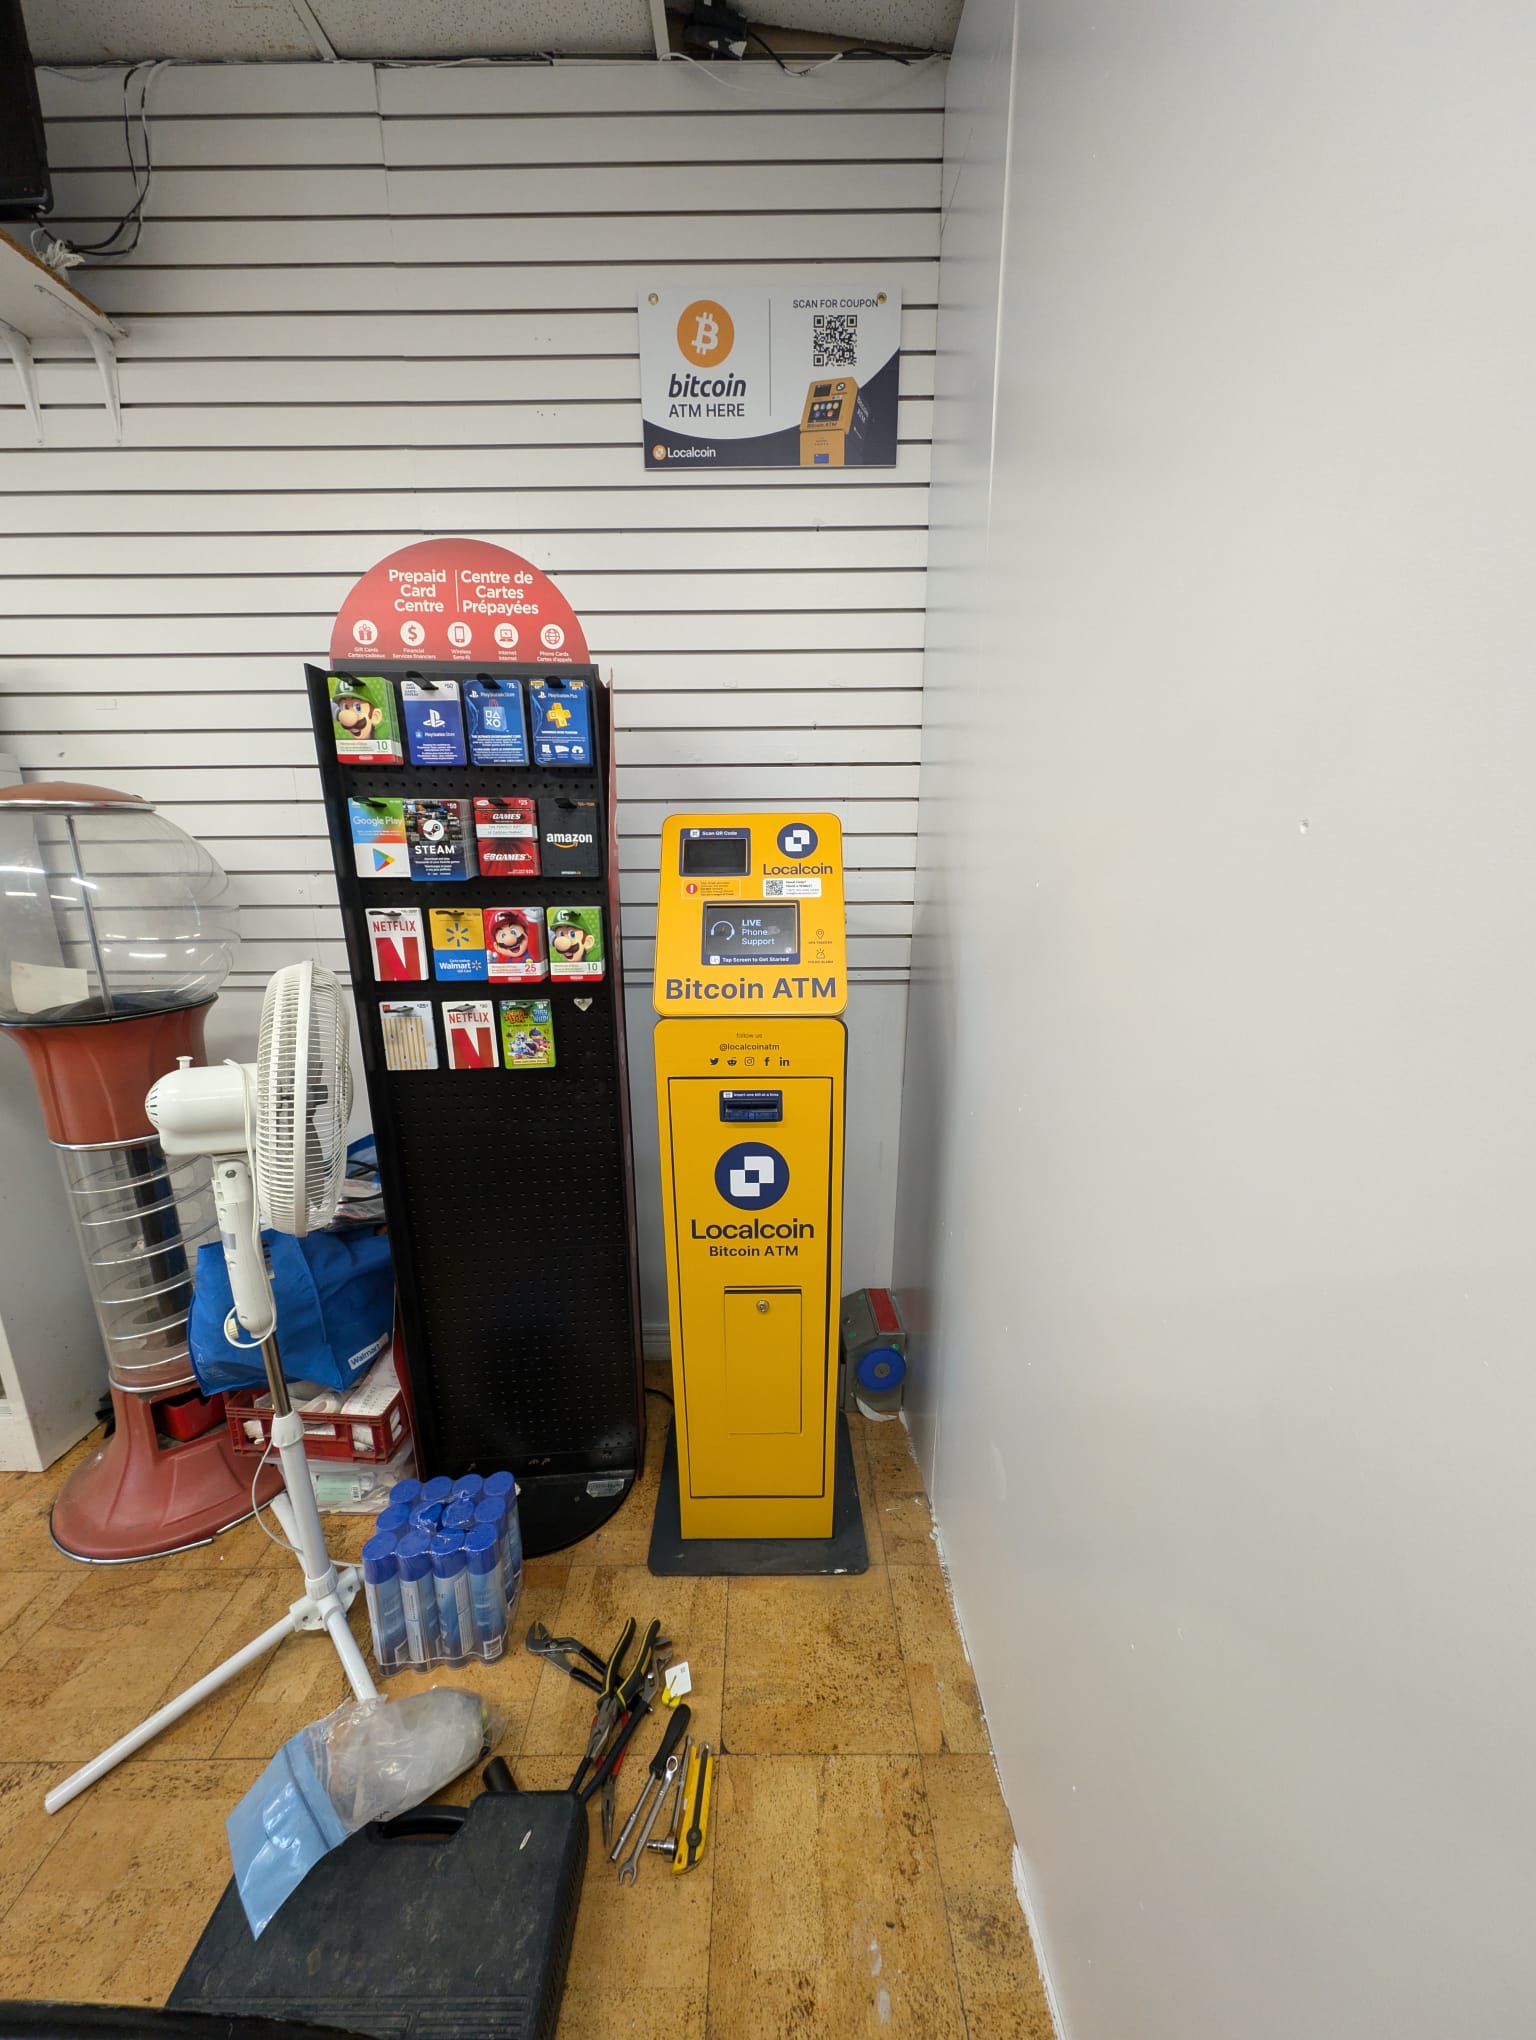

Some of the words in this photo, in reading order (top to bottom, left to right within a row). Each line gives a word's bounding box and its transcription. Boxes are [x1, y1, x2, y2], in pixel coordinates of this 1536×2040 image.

[793, 299, 818, 309] SCAN
[820, 299, 838, 309] FOR
[840, 298, 879, 308] COUPON
[668, 372, 747, 399] bitcoin
[668, 404, 702, 418] ATM
[706, 403, 745, 417] HERE
[667, 446, 716, 458] Localcoin
[388, 569, 447, 584] Prepaid
[461, 570, 511, 584] Centre
[513, 571, 534, 584] de
[400, 584, 436, 598] Card
[475, 585, 524, 599] Cartes
[394, 599, 445, 613] Centre
[462, 599, 539, 616] Prépayées
[376, 740, 388, 750] 10
[353, 816, 385, 826] Google
[385, 816, 403, 826] Play
[546, 833, 593, 843] amazon
[414, 845, 455, 855] STEAM
[762, 863, 833, 875] Localcoin
[372, 920, 416, 933] NETFLIX
[741, 919, 762, 927] LIVE
[741, 928, 768, 936] Phone
[741, 938, 775, 947] Support
[439, 962, 471, 970] Walmart
[524, 964, 537, 973] 25
[586, 963, 598, 971] 10
[666, 977, 764, 1000] Bitcoin
[772, 977, 836, 999] ATM
[448, 1012, 490, 1024] NETFLIX
[719, 1043, 780, 1051] @localcoinatm
[691, 1217, 815, 1240] Localcoin
[709, 1245, 761, 1258] Bitcoin
[764, 1245, 799, 1257] ATM
[350, 1343, 381, 1367] Walmart
